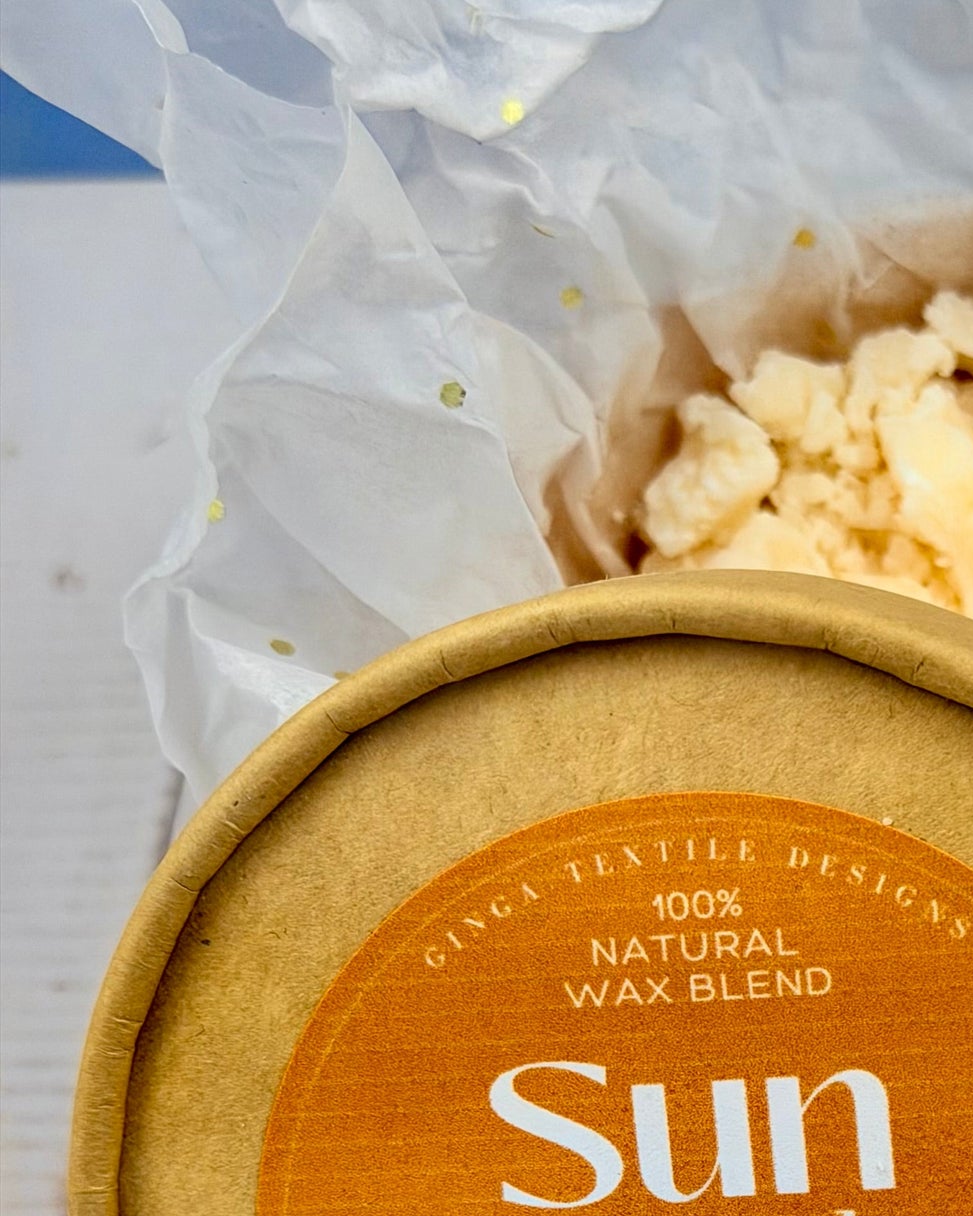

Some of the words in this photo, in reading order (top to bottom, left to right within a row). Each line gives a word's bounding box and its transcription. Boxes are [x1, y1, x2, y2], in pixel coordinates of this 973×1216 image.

[424, 883, 541, 969] GINGA
[564, 837, 756, 883] TEXTILE
[788, 846, 972, 940] DESIGNS
[652, 888, 743, 921] 100%
[591, 928, 799, 967] NATURAL
[564, 975, 672, 1009] WAX
[689, 967, 832, 1002] BLEND
[489, 1061, 896, 1208] Sun
